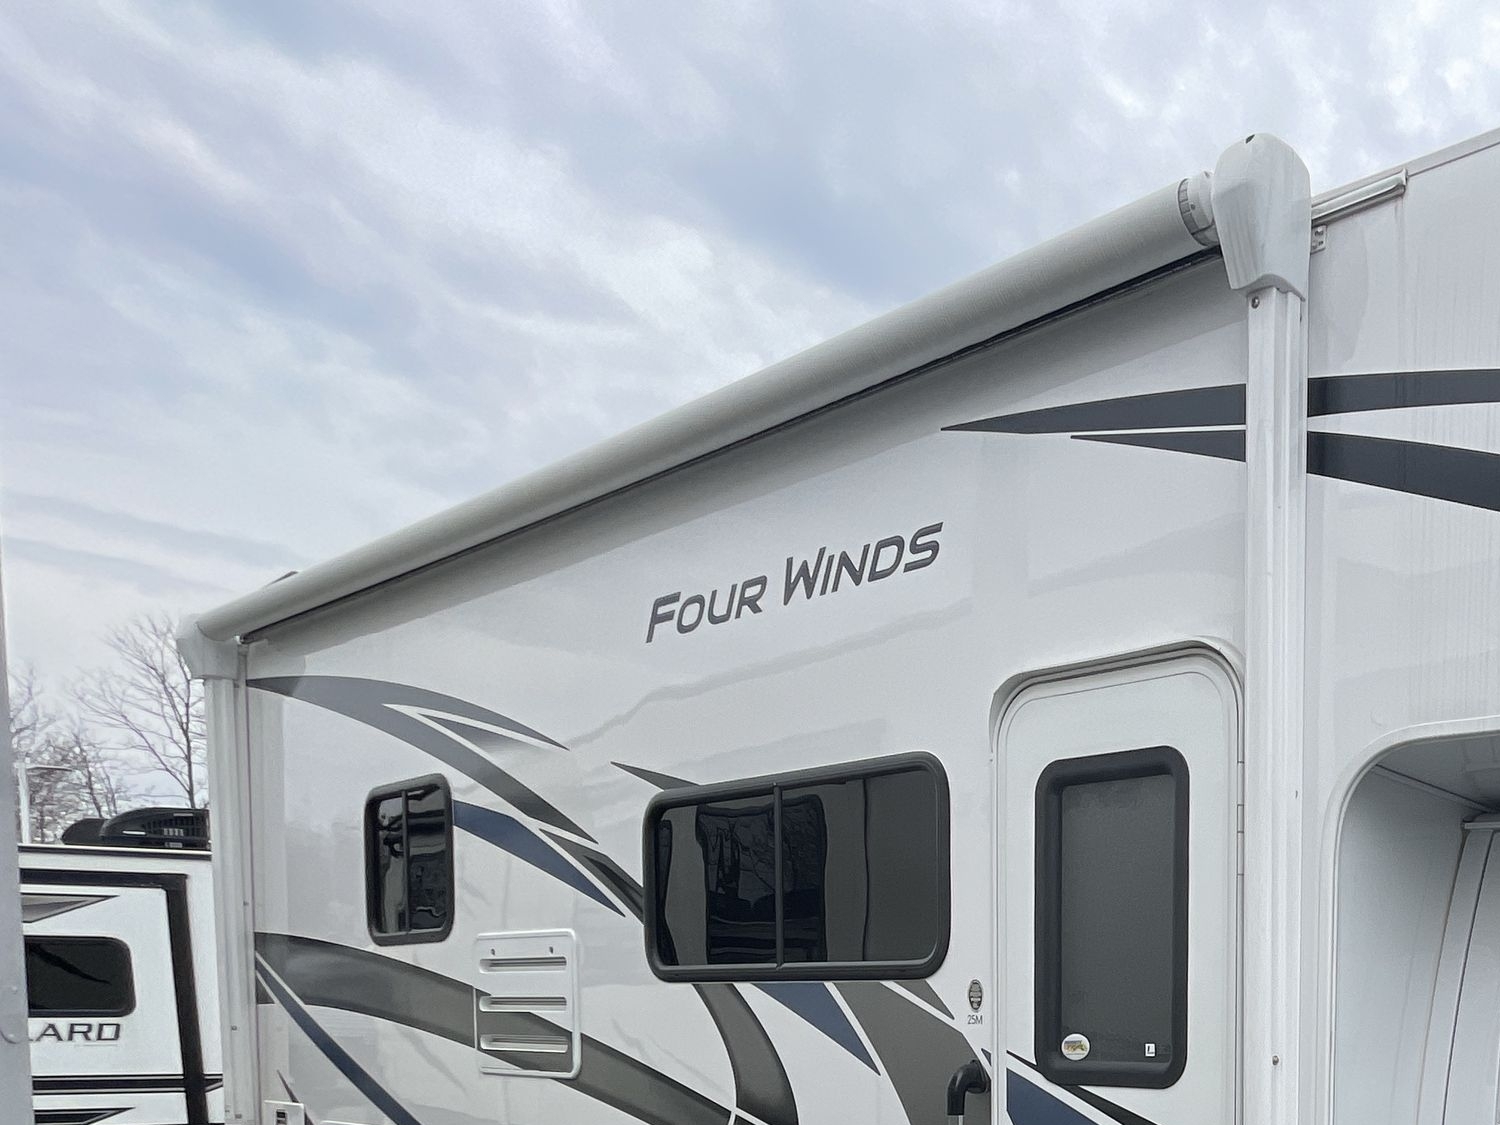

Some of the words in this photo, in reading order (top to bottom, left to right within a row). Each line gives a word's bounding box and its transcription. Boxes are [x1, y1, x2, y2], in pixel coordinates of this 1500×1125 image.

[646, 575, 768, 643] FOUR
[783, 521, 944, 606] WINDS
[967, 1014, 983, 1025] 25M
[29, 1022, 121, 1042] ARD
